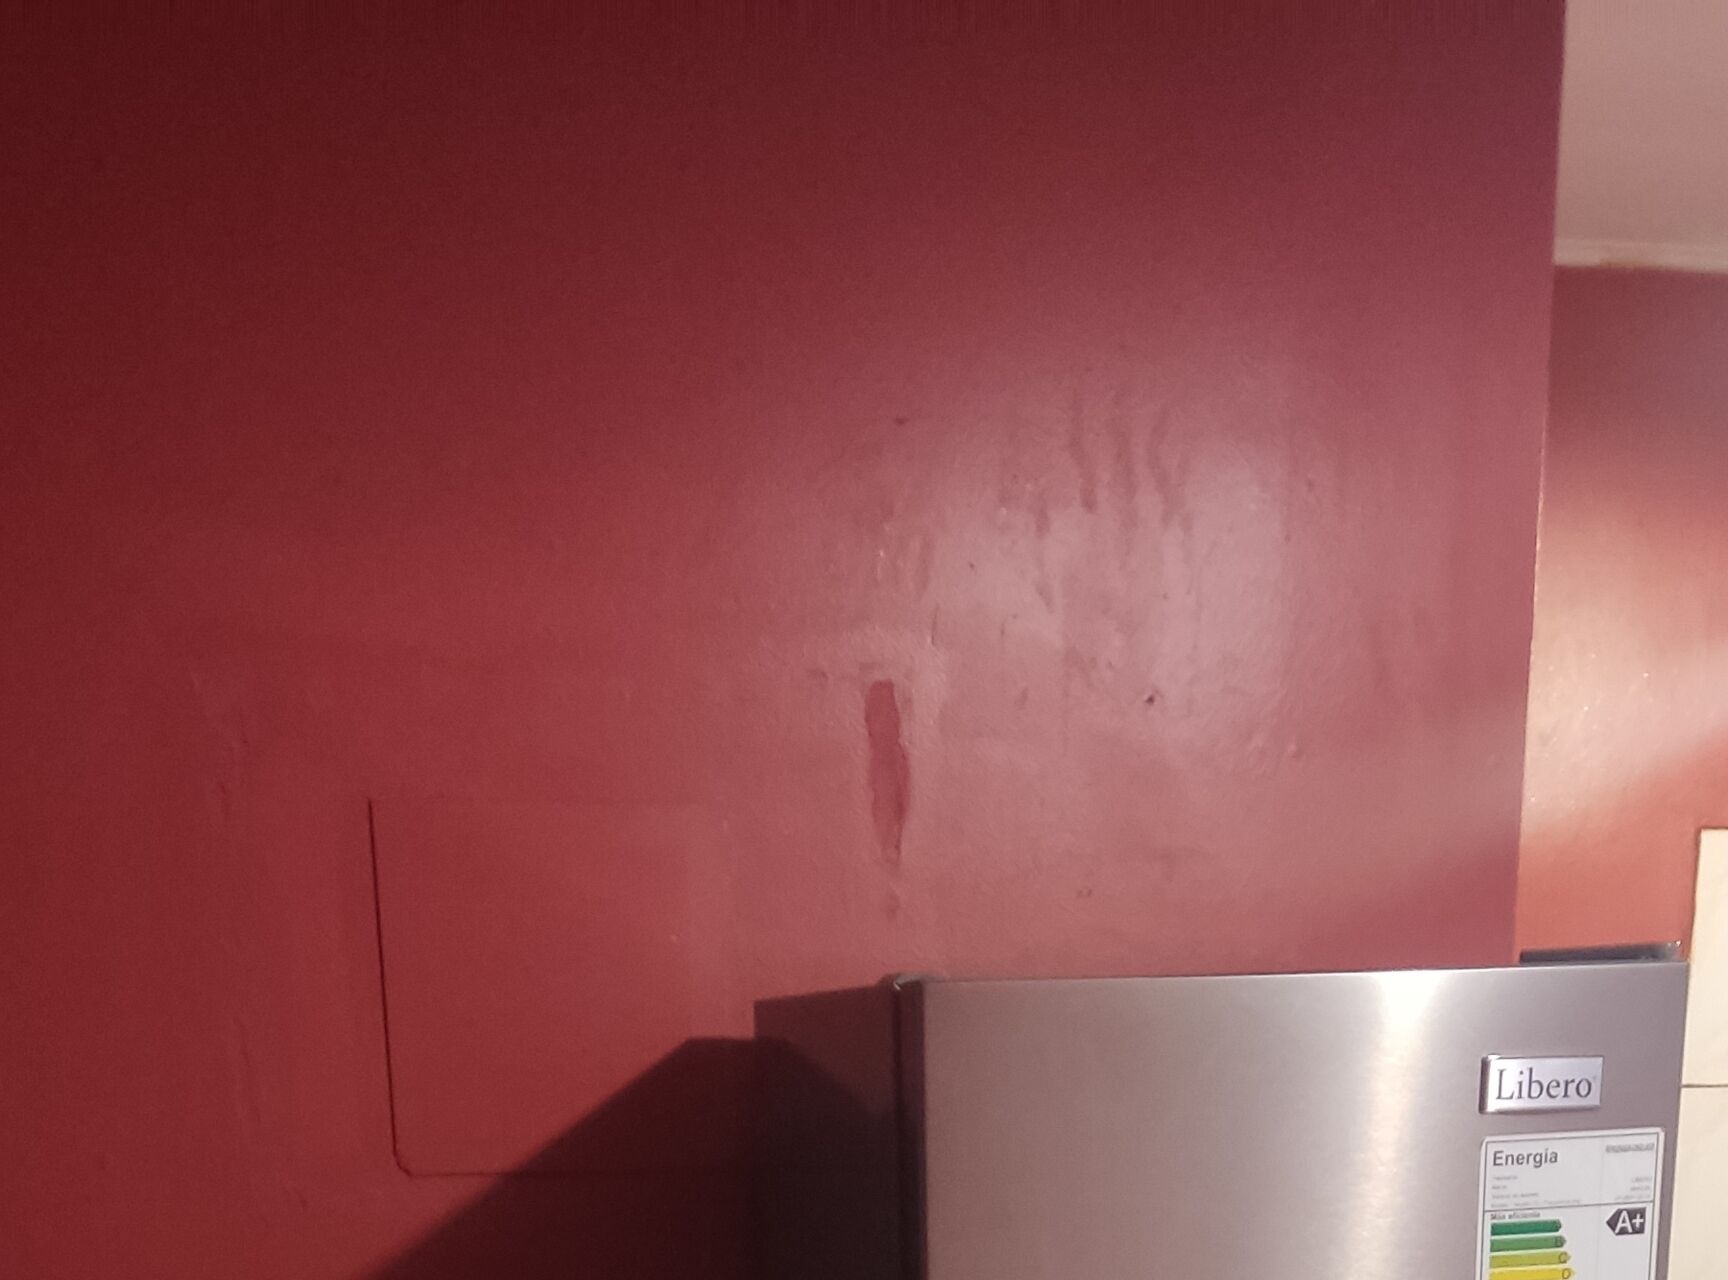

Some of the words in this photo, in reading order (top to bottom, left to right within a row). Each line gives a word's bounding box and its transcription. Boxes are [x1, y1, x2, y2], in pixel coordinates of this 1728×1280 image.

[1495, 1066, 1592, 1100] Libero
[1493, 1148, 1559, 1168] Energía
[1614, 1210, 1644, 1233] A+
